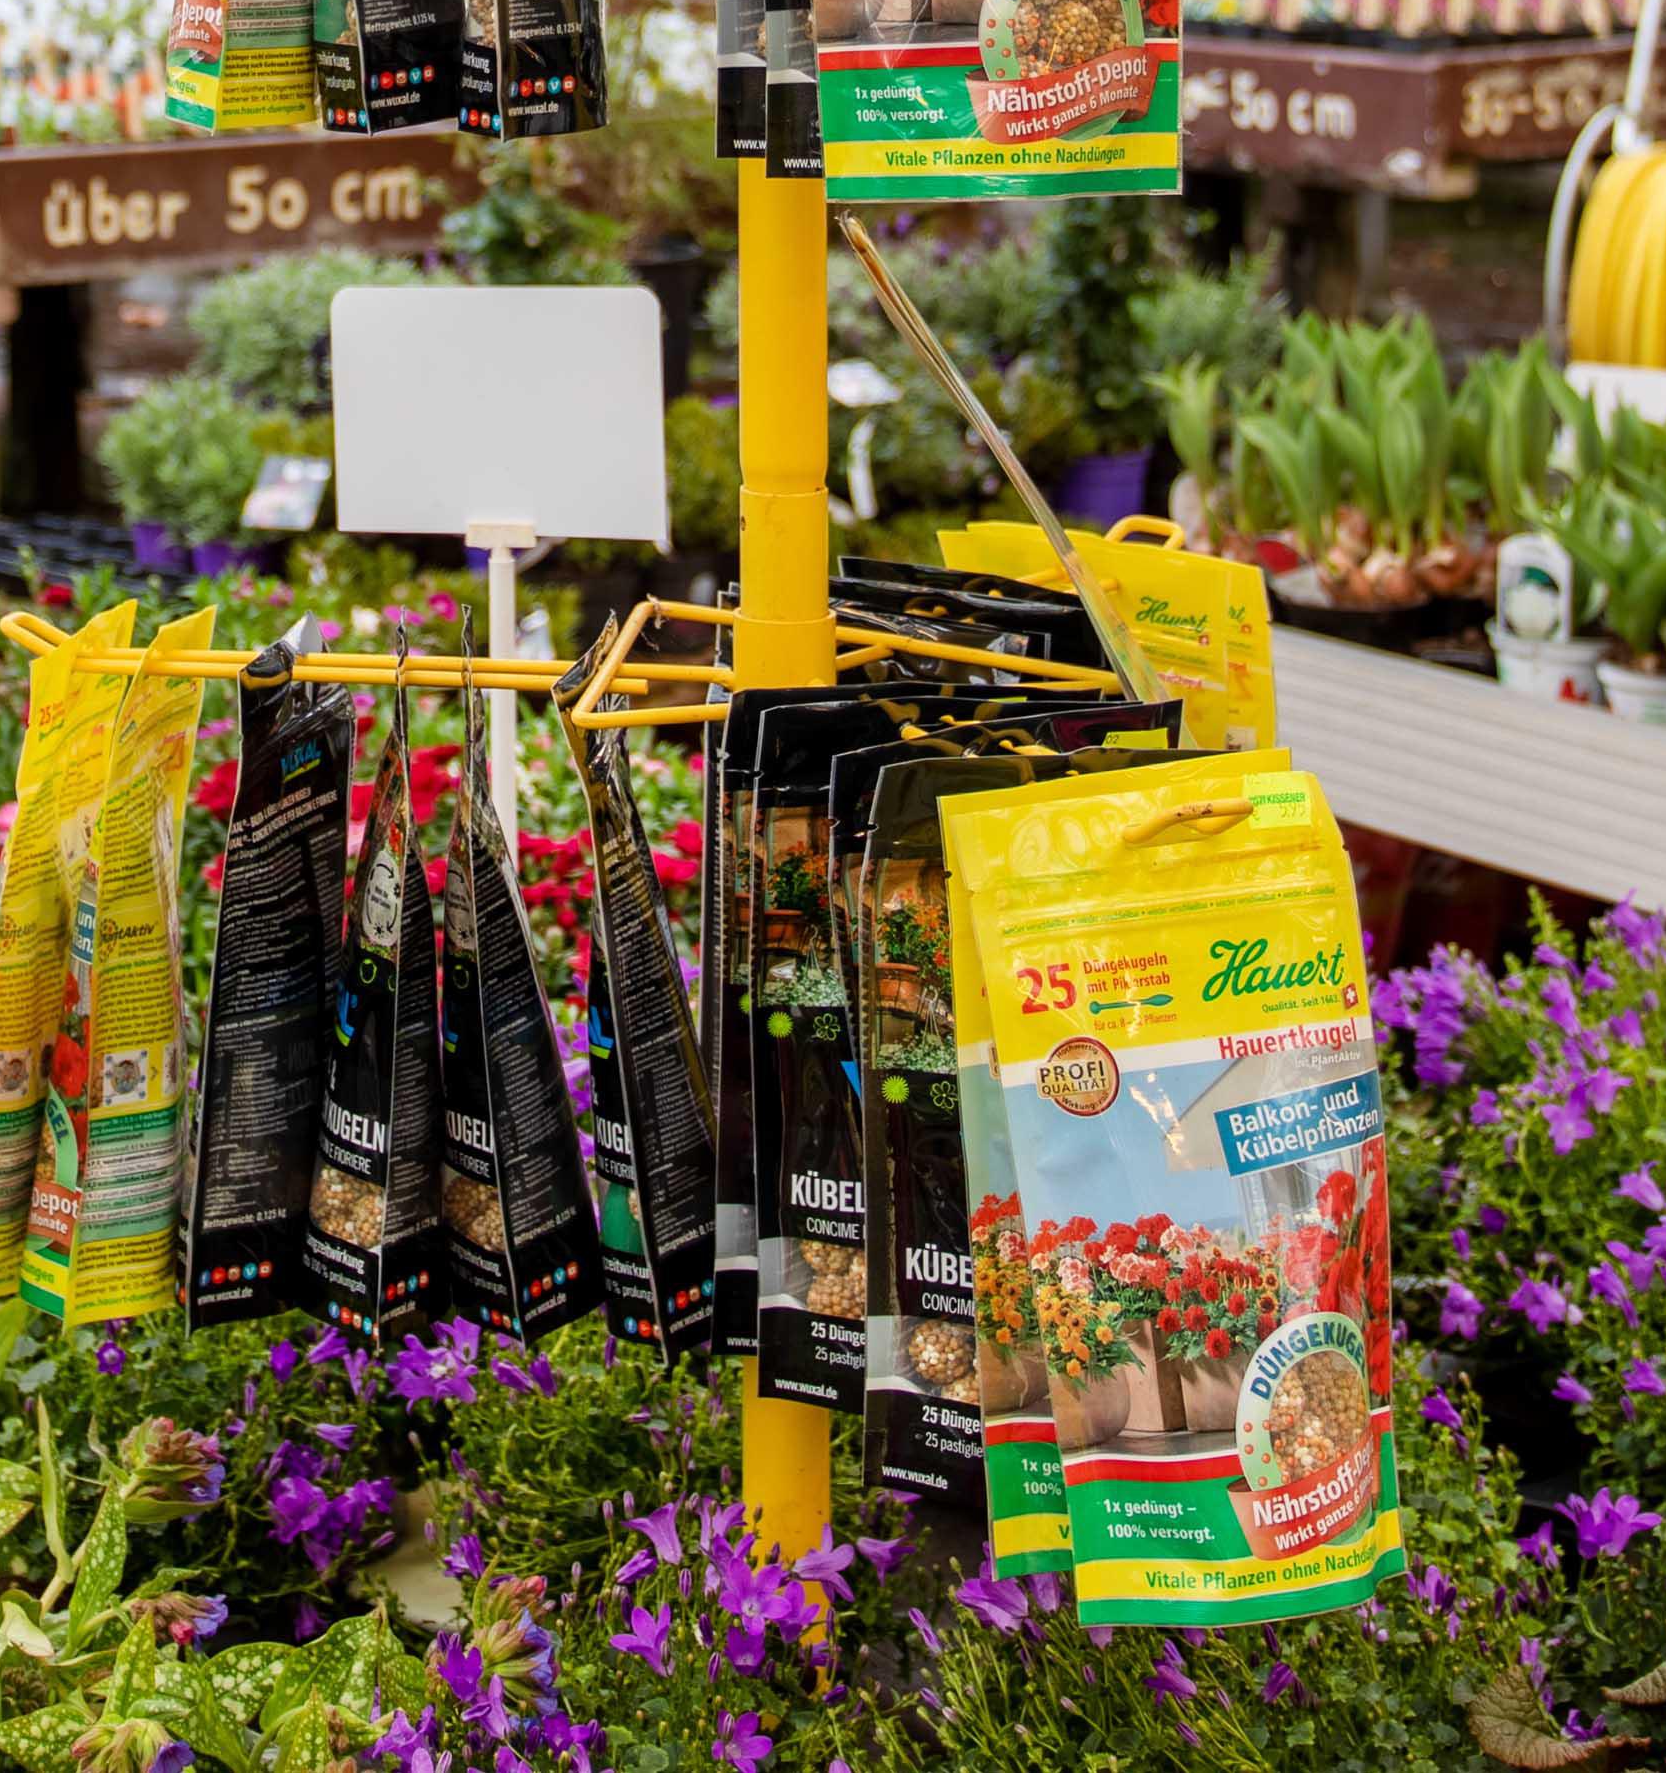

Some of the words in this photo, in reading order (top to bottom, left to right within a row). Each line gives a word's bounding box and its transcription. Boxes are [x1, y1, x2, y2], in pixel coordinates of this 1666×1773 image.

[855, 87, 868, 100] 1x
[870, 85, 922, 103] gedüngt
[987, 54, 1149, 115] Nährstoff-Depot
[855, 109, 888, 122] 100%
[890, 109, 948, 125] versorgt.
[1006, 118, 1050, 137] Wirkt
[1052, 105, 1088, 129] ganze
[1089, 97, 1097, 109] 6
[1099, 85, 1138, 107] Monate
[886, 151, 927, 167] Vitale
[933, 150, 1004, 167] Pflanzen
[1011, 149, 1052, 164] ohne
[1056, 146, 1125, 165] Nachdüngen
[43, 176, 190, 249] über
[226, 164, 308, 232] 50
[333, 165, 424, 225] cm
[1136, 595, 1208, 633] Hauert
[1084, 952, 1168, 977] Düngekugeln
[1202, 938, 1346, 1003] Hauert
[1017, 963, 1077, 1015] 25
[1086, 980, 1109, 995] mit
[1218, 1017, 1358, 1060] Hauertkugel
[1039, 1060, 1105, 1084] PROFI
[1041, 1077, 1107, 1096] QUALITÄT
[1229, 1101, 1319, 1136] Balkon-
[1323, 1082, 1360, 1113] und
[1237, 1109, 1380, 1164] Kübelpflanzen
[806, 1217, 860, 1241] CONCIME
[811, 1322, 826, 1338] 25
[815, 1346, 828, 1361] 25
[775, 1378, 838, 1400] www.wuxal.de
[922, 1405, 938, 1423] 25
[925, 1431, 938, 1448] 25
[882, 1465, 948, 1490] www.wuxal.de
[1021, 1458, 1041, 1473] 1x
[1023, 1481, 1062, 1496] 100%
[1103, 1498, 1122, 1514] 1x
[1124, 1497, 1183, 1518] gedüngt
[1107, 1524, 1146, 1540] 100%
[1149, 1524, 1216, 1543] versorgt.
[1275, 1523, 1315, 1552] Wirkt
[1317, 1504, 1354, 1534] ganze
[1145, 1570, 1196, 1590] Vitale
[1203, 1569, 1277, 1590] Pflanzen
[1282, 1560, 1321, 1582] ohne
